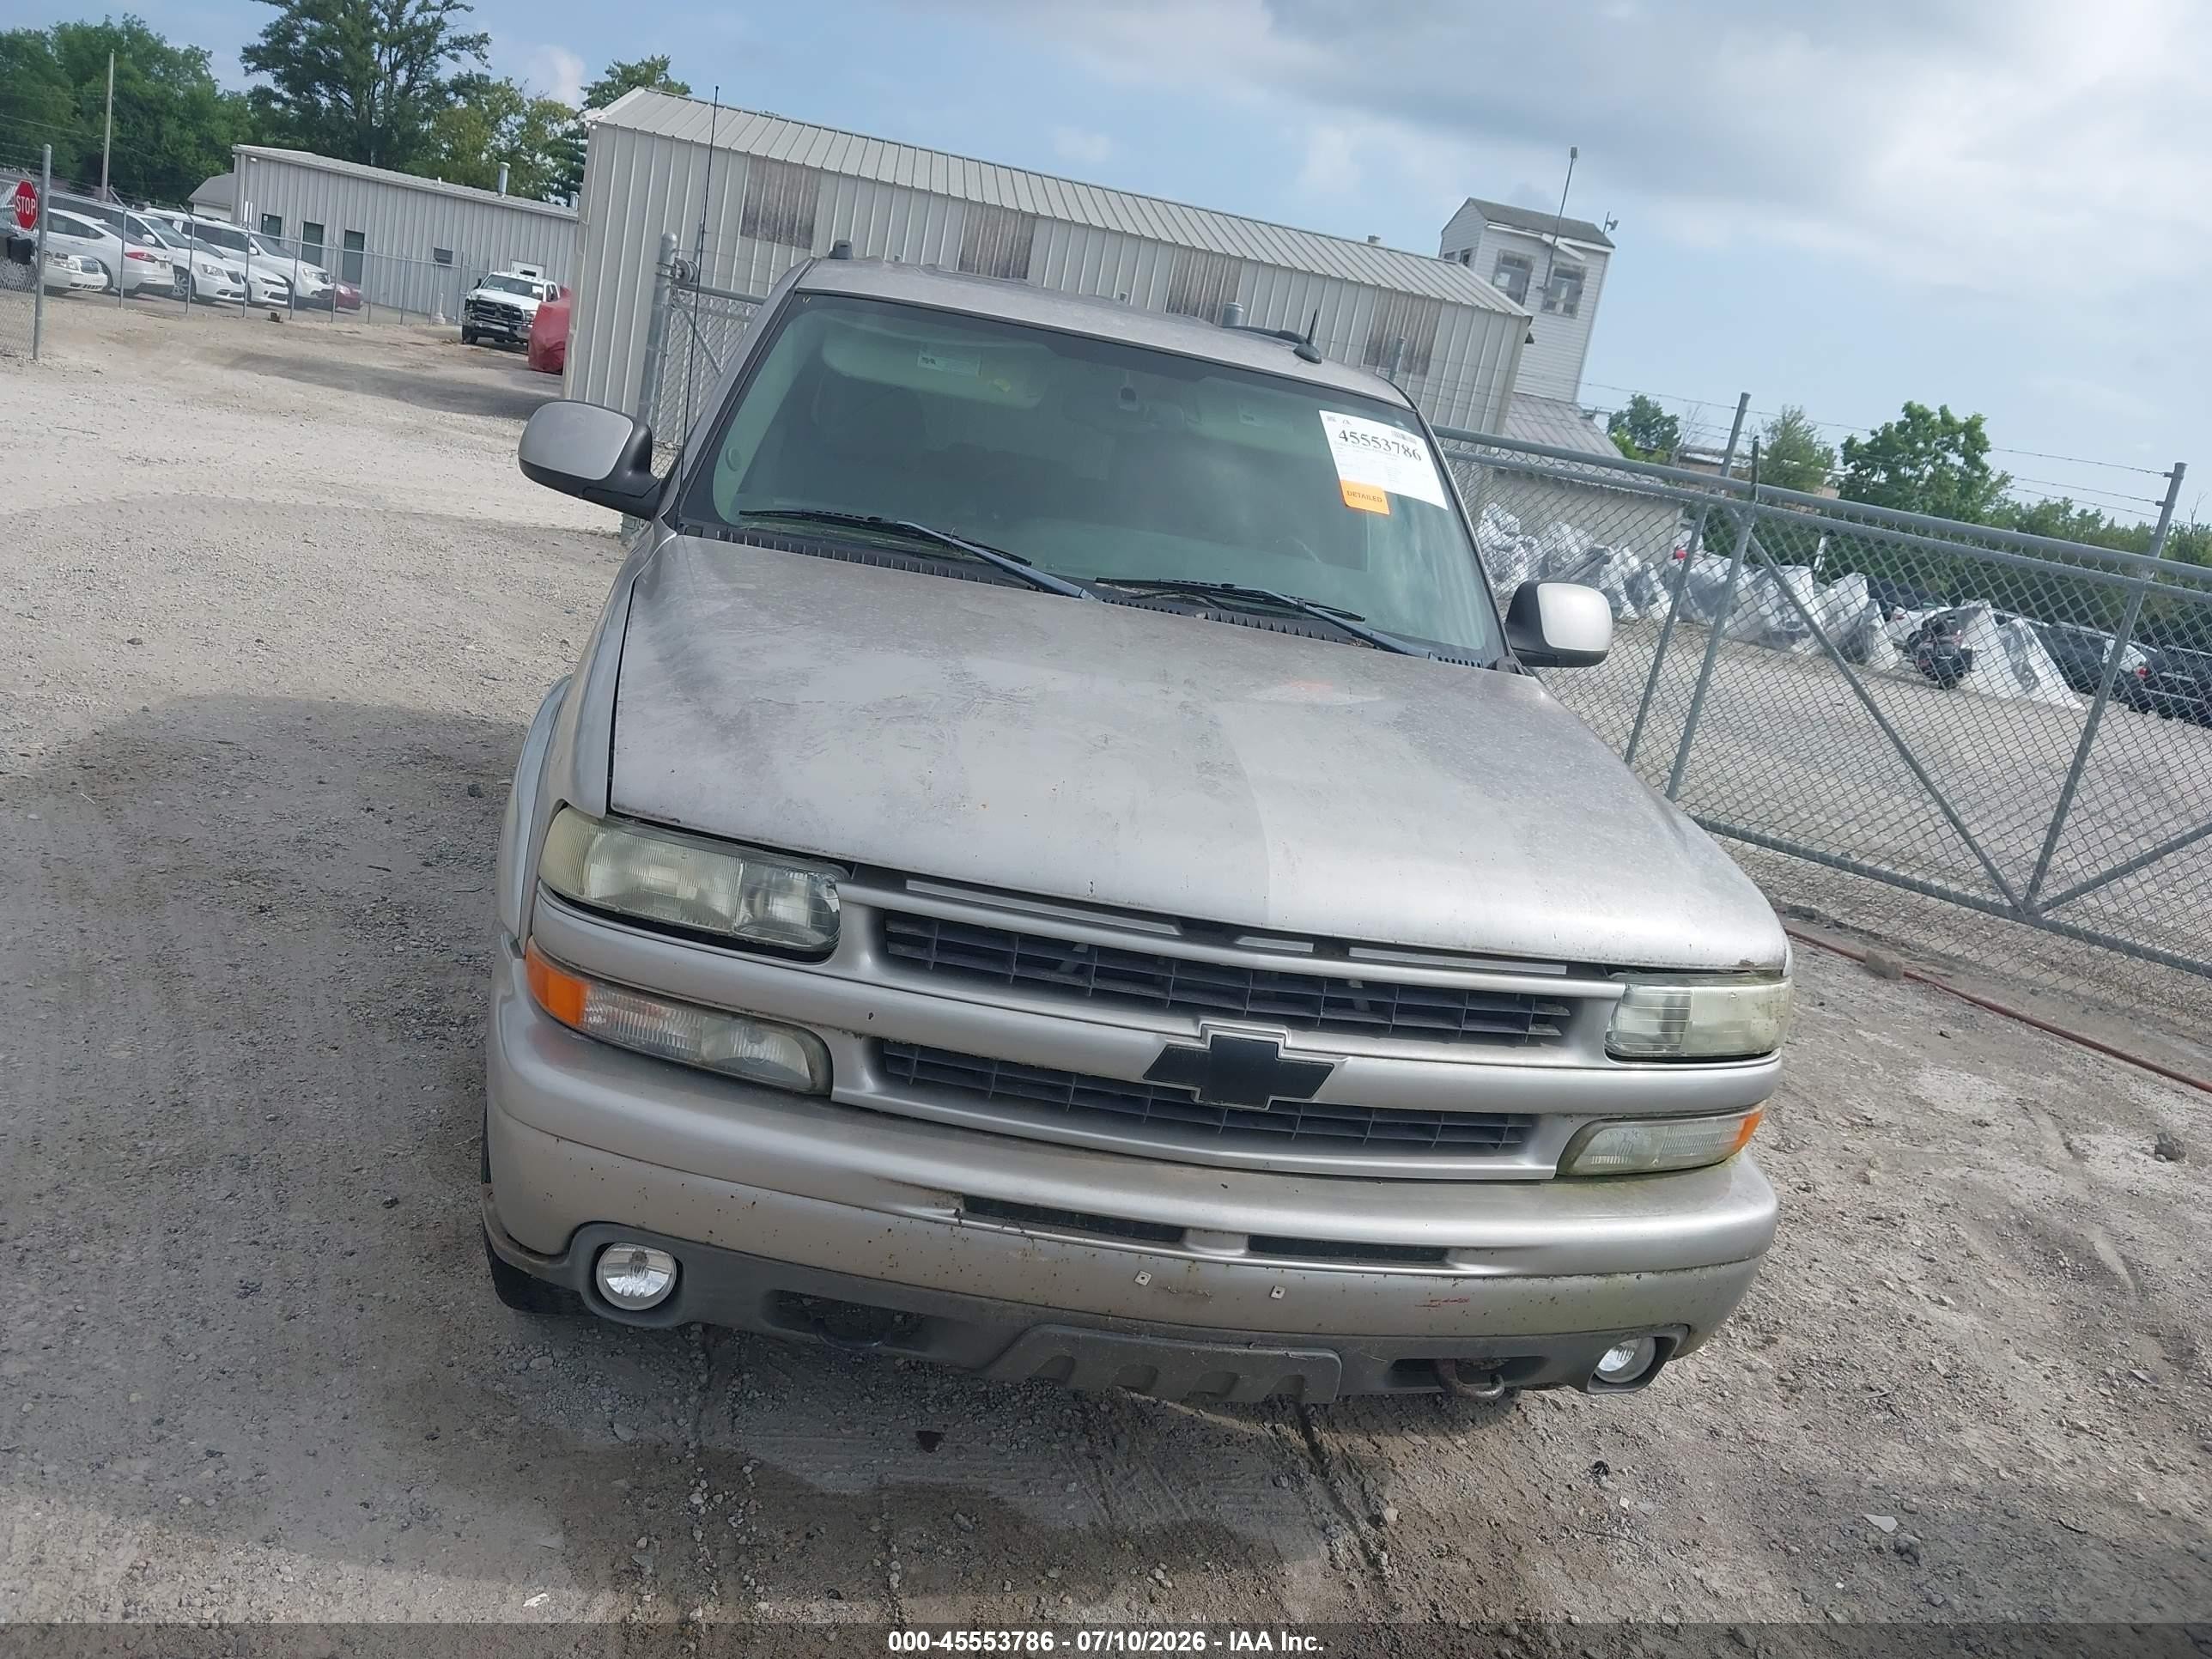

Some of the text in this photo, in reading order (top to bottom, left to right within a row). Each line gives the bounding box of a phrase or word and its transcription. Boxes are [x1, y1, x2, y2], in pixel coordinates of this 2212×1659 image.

[15, 195, 36, 216] STOP
[1339, 429, 1422, 461] 45553786
[1346, 489, 1383, 503] DETAILED
